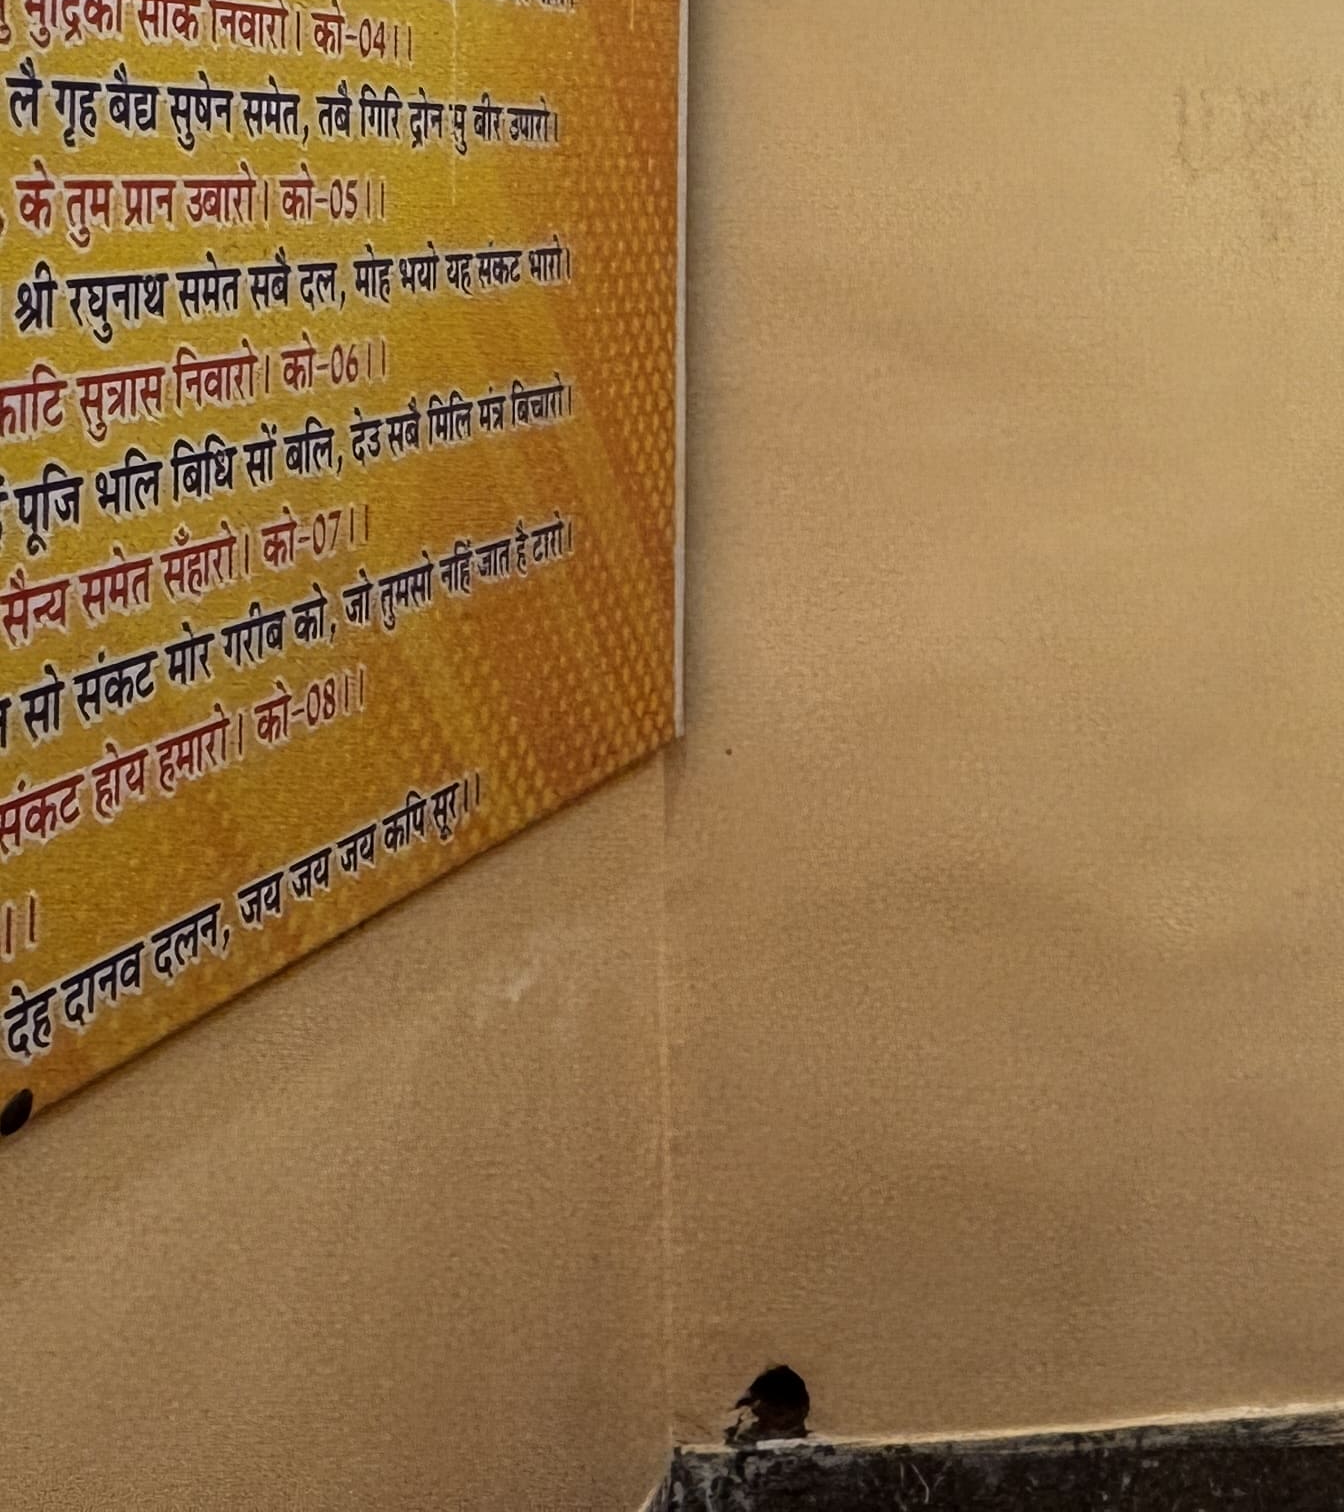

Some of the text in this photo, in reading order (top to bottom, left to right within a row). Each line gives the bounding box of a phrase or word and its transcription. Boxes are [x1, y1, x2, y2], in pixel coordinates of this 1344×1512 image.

[5, 56, 43, 128] लै
[51, 80, 102, 147] गृह
[166, 70, 238, 152] सुषेन
[358, 83, 403, 140] गिरि
[407, 86, 445, 149] द्रोन
[15, 158, 55, 230] के
[63, 180, 114, 248] तुम
[120, 179, 177, 226] प्रान
[76, 366, 166, 442] सुत्रास
[19, 663, 65, 741] सो
[72, 650, 159, 721] संकट
[164, 621, 215, 685] मोर
[220, 601, 287, 666] गरीब
[343, 567, 374, 624] जो
[377, 549, 434, 634] तुमसो
[476, 538, 511, 577] जात
[514, 519, 529, 574] है
[91, 742, 149, 818] होय
[3, 985, 57, 1057] देह
[60, 941, 145, 1026] दानव
[237, 871, 284, 923] जय
[288, 846, 333, 897] जय
[335, 823, 377, 872] जय
[382, 790, 427, 852] कपि
